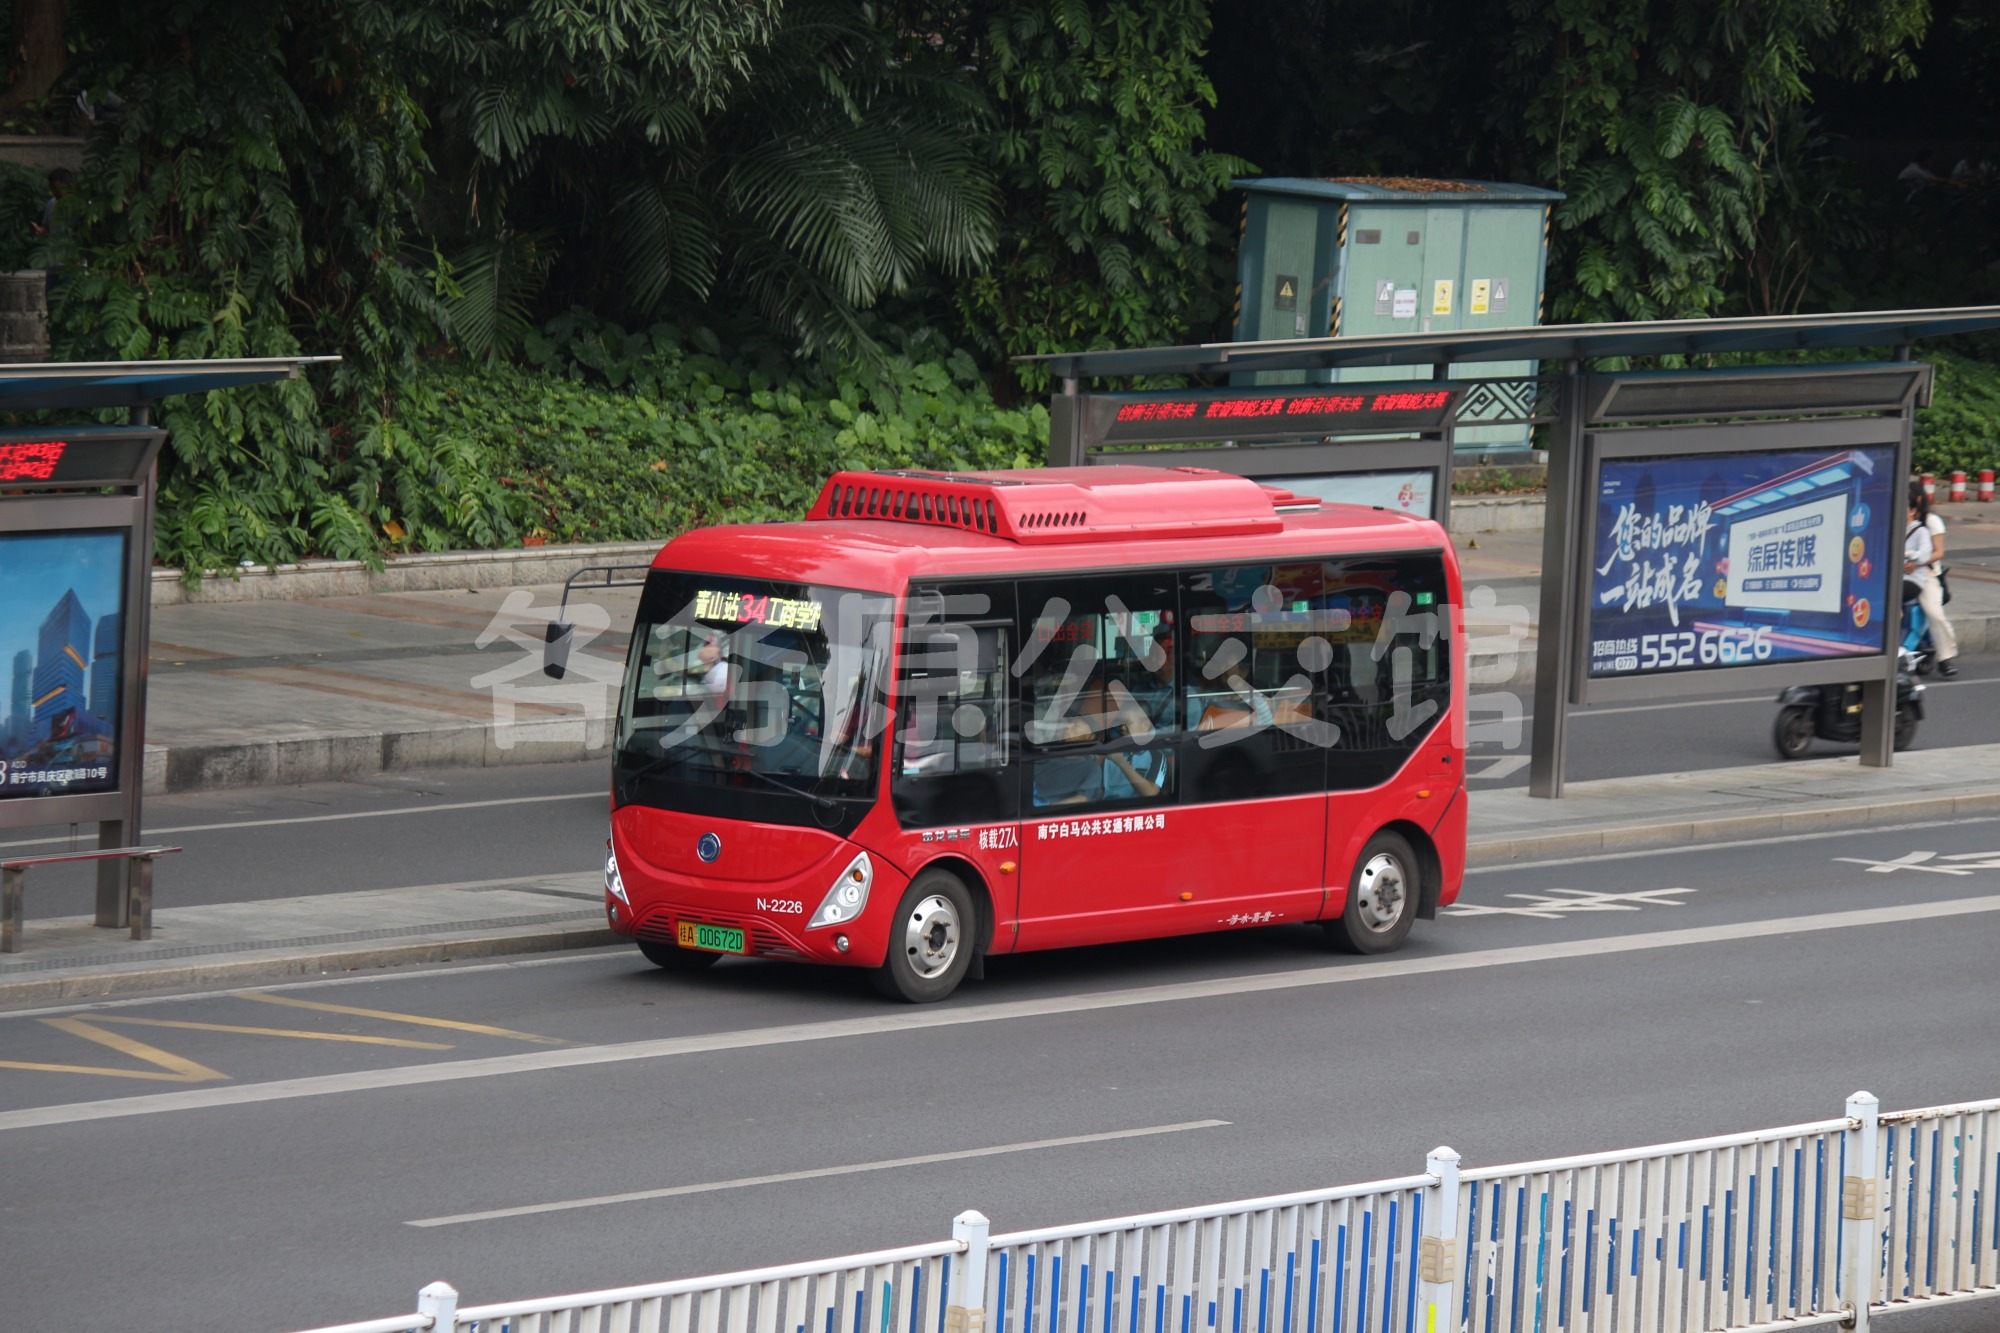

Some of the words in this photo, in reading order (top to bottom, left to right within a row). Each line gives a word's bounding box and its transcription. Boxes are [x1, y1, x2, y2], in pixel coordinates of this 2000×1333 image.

[1596, 500, 1717, 577] 您的品牌
[1600, 551, 1703, 627] 一站成名
[1593, 638, 1639, 657] 招商热线
[1641, 632, 1696, 669] 552
[1700, 626, 1773, 664] 6626
[979, 826, 1019, 850] 核载27人
[1037, 814, 1166, 841] 南宁白马公共交通有限公司
[756, 897, 803, 914] N-2226
